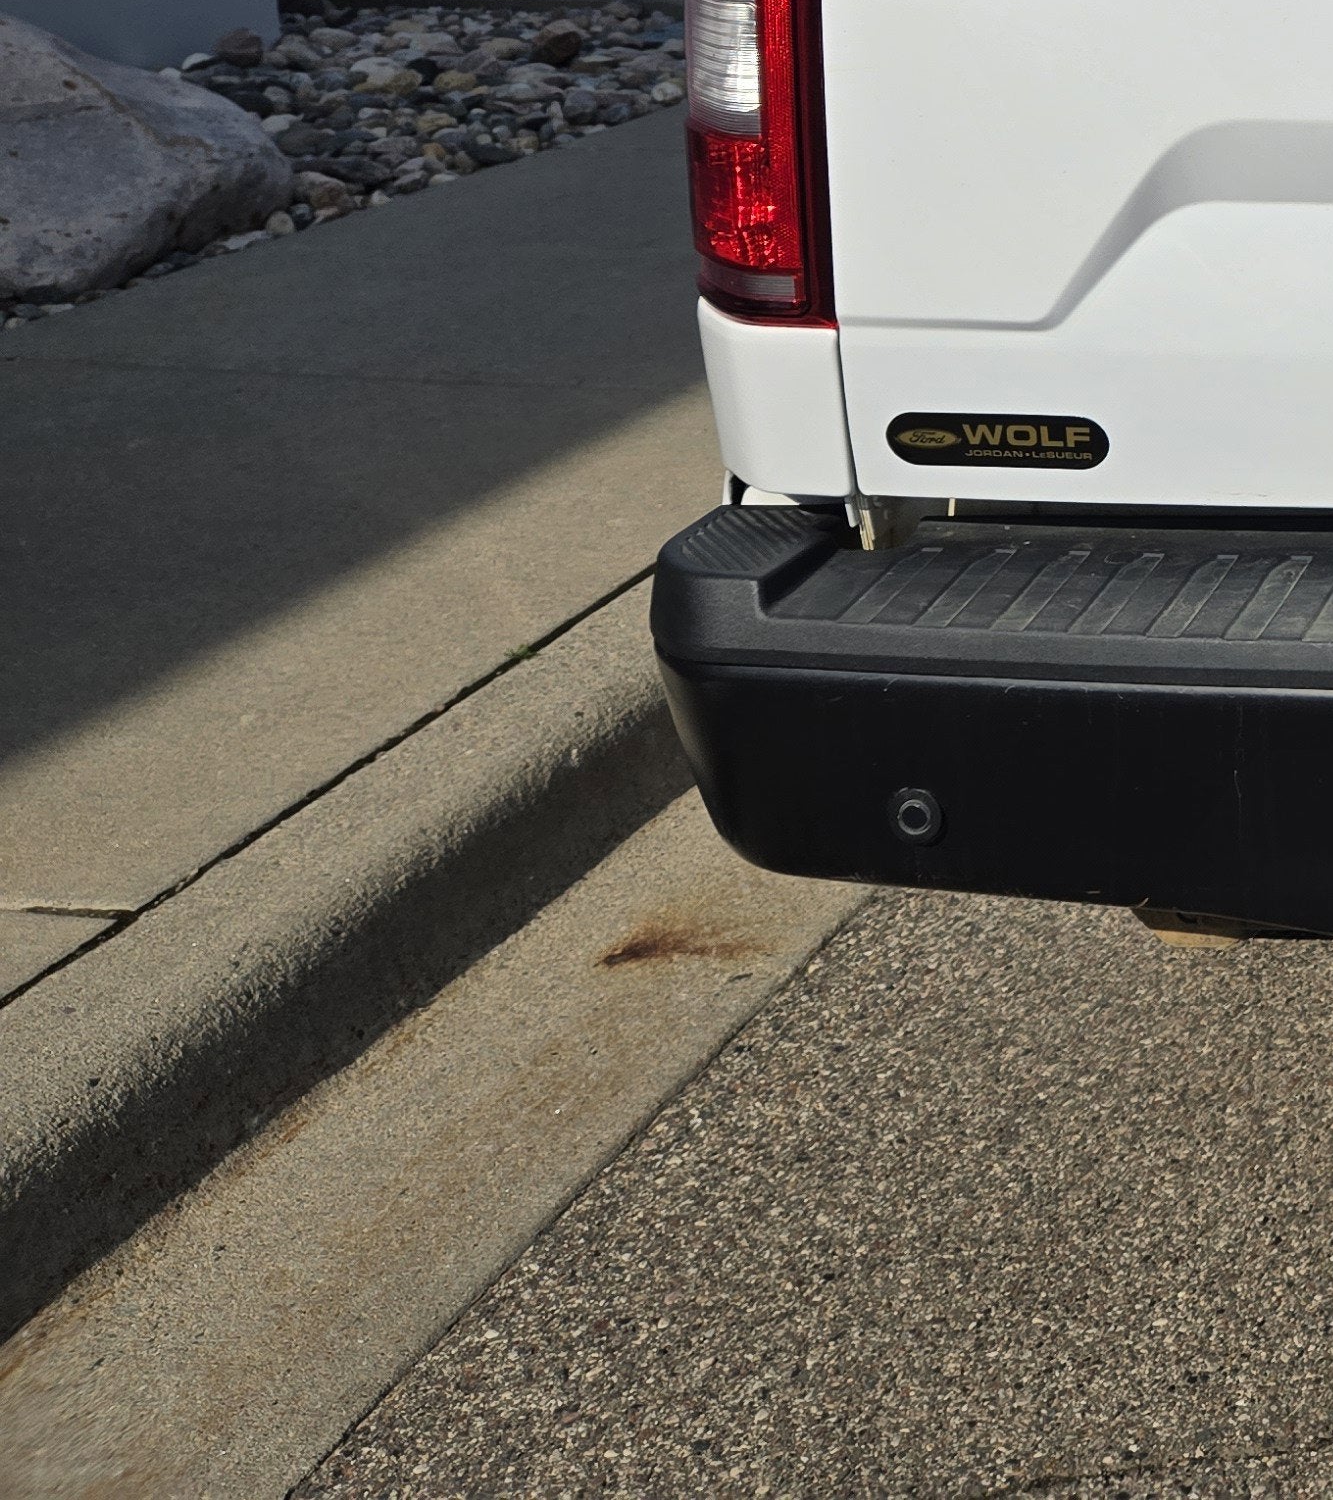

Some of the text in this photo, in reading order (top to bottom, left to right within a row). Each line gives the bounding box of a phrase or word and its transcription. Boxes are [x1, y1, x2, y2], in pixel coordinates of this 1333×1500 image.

[909, 429, 946, 444] Ford
[962, 424, 1091, 447] WOLF
[965, 450, 1023, 458] JORDAN
